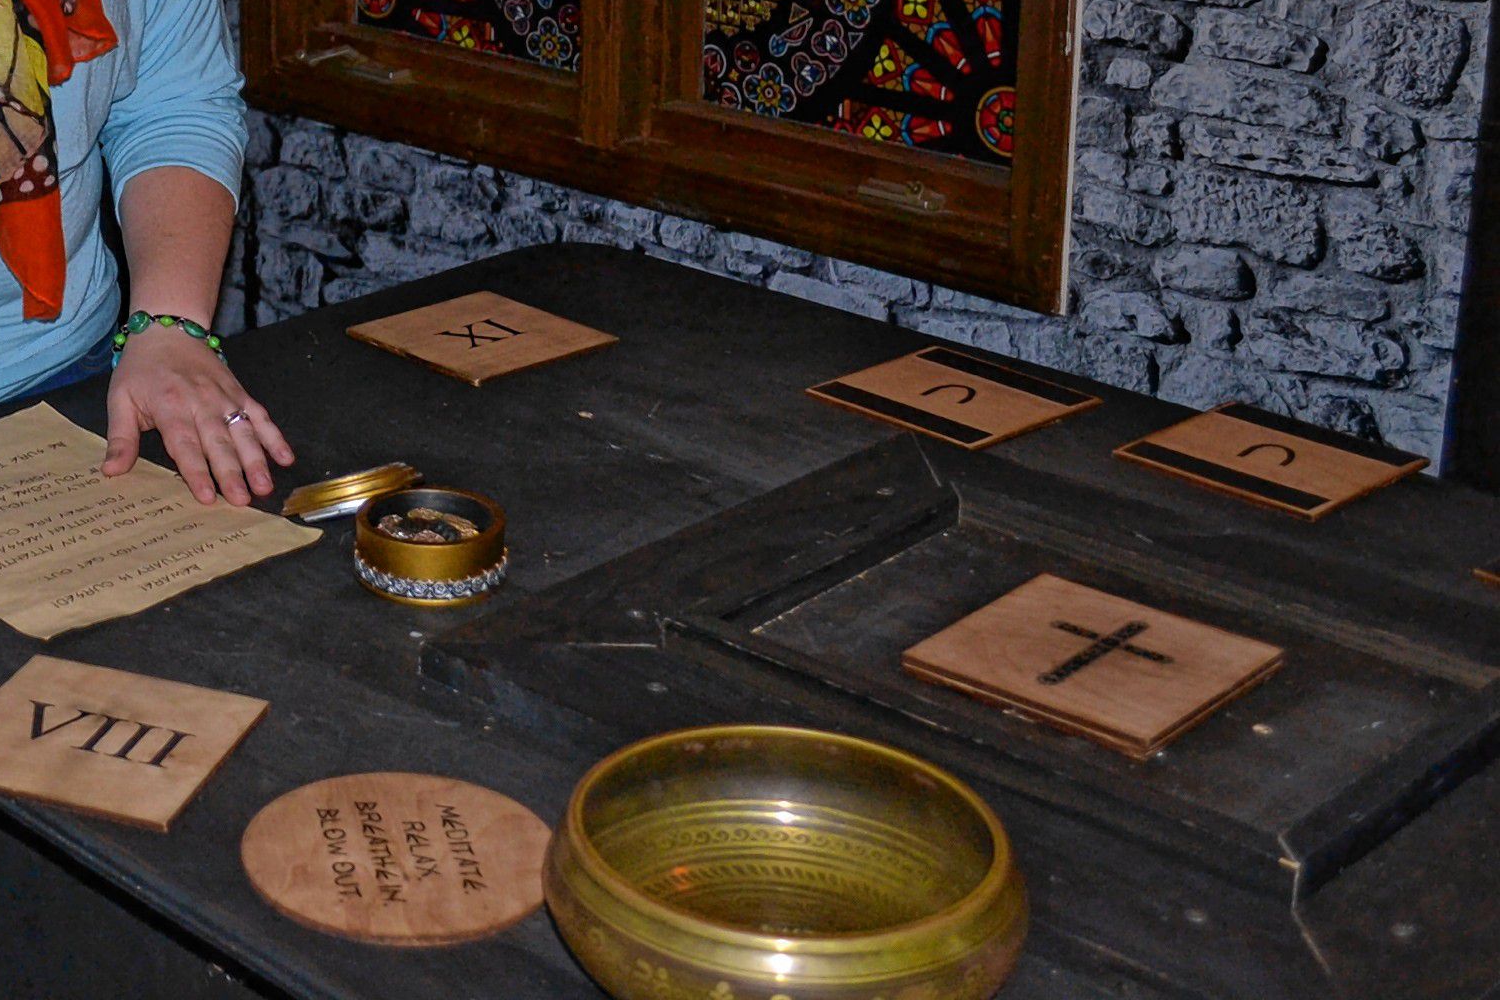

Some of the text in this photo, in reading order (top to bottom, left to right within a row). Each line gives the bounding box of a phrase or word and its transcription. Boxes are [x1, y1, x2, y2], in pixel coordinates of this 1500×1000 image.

[144, 505, 173, 517] BEG
[113, 516, 144, 528] YOU
[172, 522, 204, 533] YOU
[92, 526, 111, 535] TO
[61, 534, 87, 547] PAY
[141, 533, 167, 546] MAY
[108, 545, 136, 557] NOT
[53, 530, 249, 608] THIS SANCTUARY IS CURSED!
[77, 557, 104, 568] GET
[139, 563, 201, 591] BEWARE!
[29, 699, 197, 768] VIII
[316, 808, 362, 903] BLOW OUT.
[402, 821, 441, 882] RELAX.
[436, 803, 488, 895] MEDITATE.
